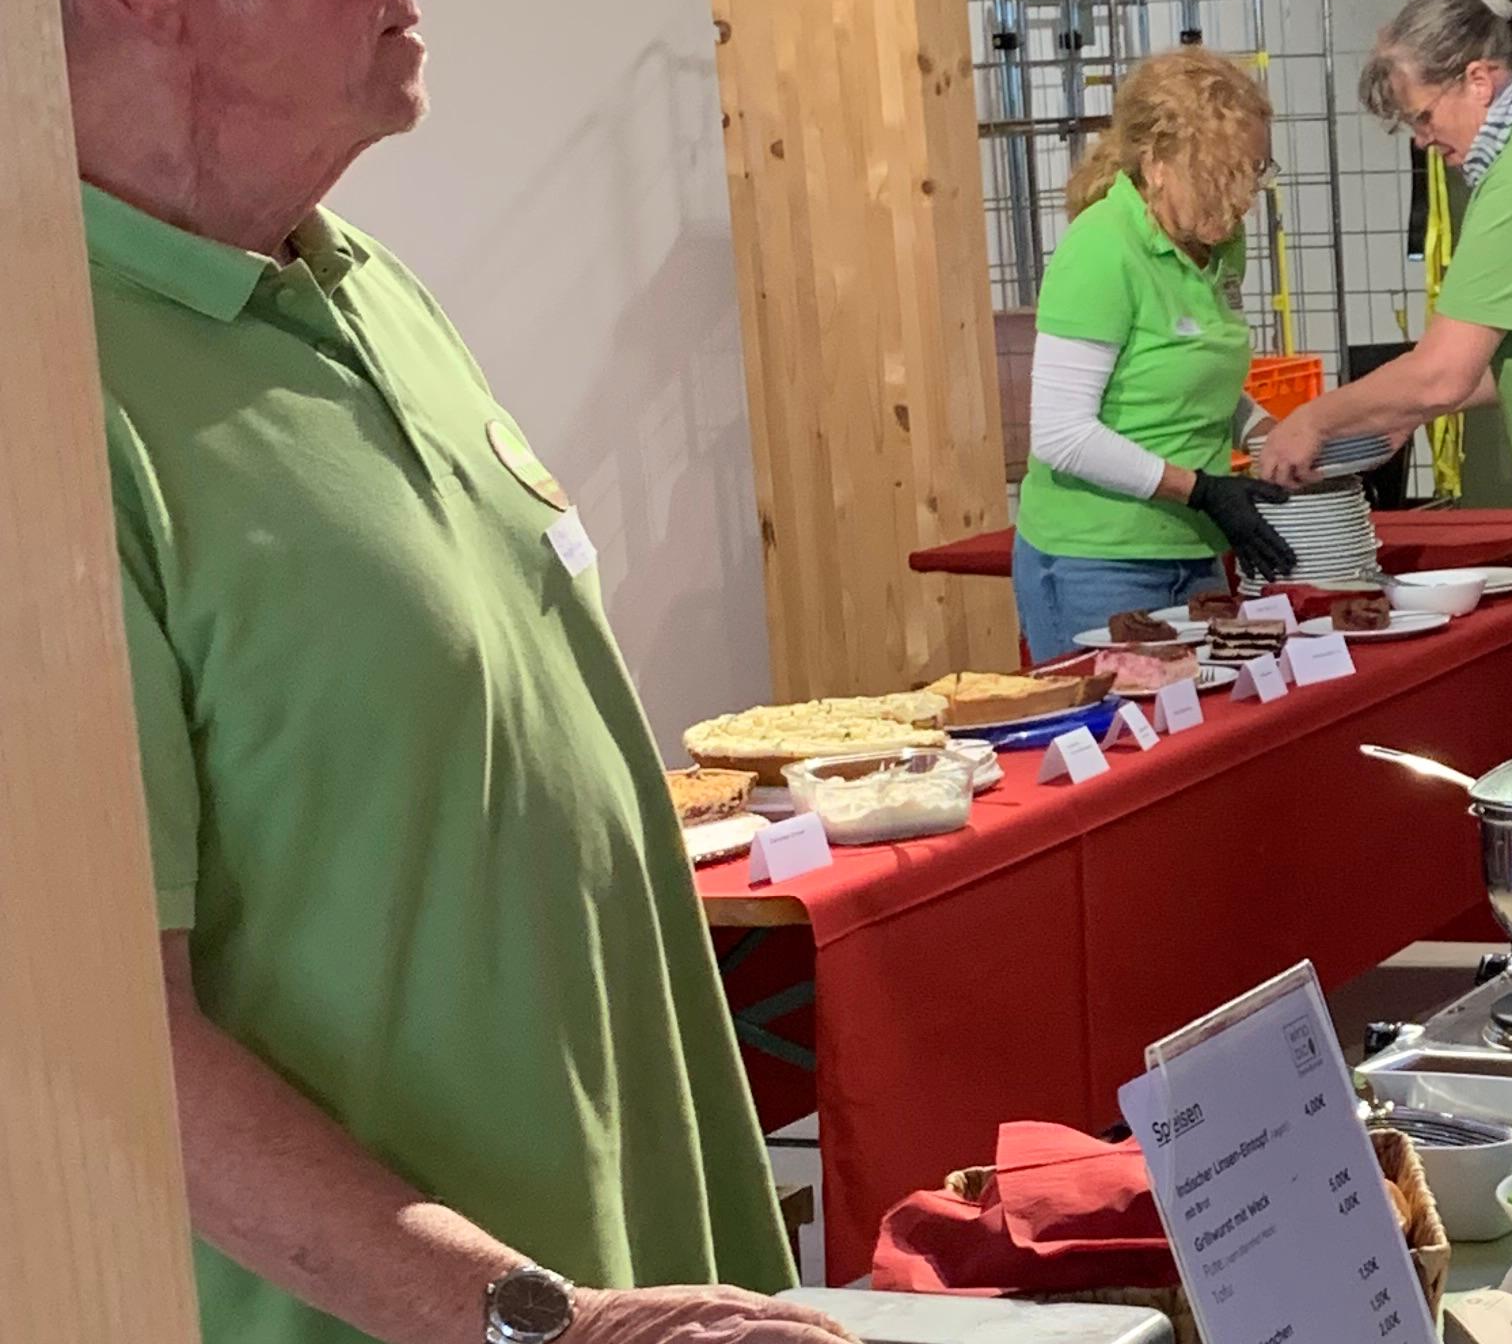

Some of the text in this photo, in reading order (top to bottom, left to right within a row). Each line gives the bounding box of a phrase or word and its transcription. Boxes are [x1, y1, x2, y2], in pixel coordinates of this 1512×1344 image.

[1151, 1101, 1204, 1145] Speisen
[1174, 1163, 1214, 1200] Indischer
[1301, 1091, 1327, 1119] 4,00€
[1192, 1214, 1235, 1253] Grillwurst
[1246, 1190, 1270, 1217] Weck
[1337, 1190, 1361, 1218] 4,00€
